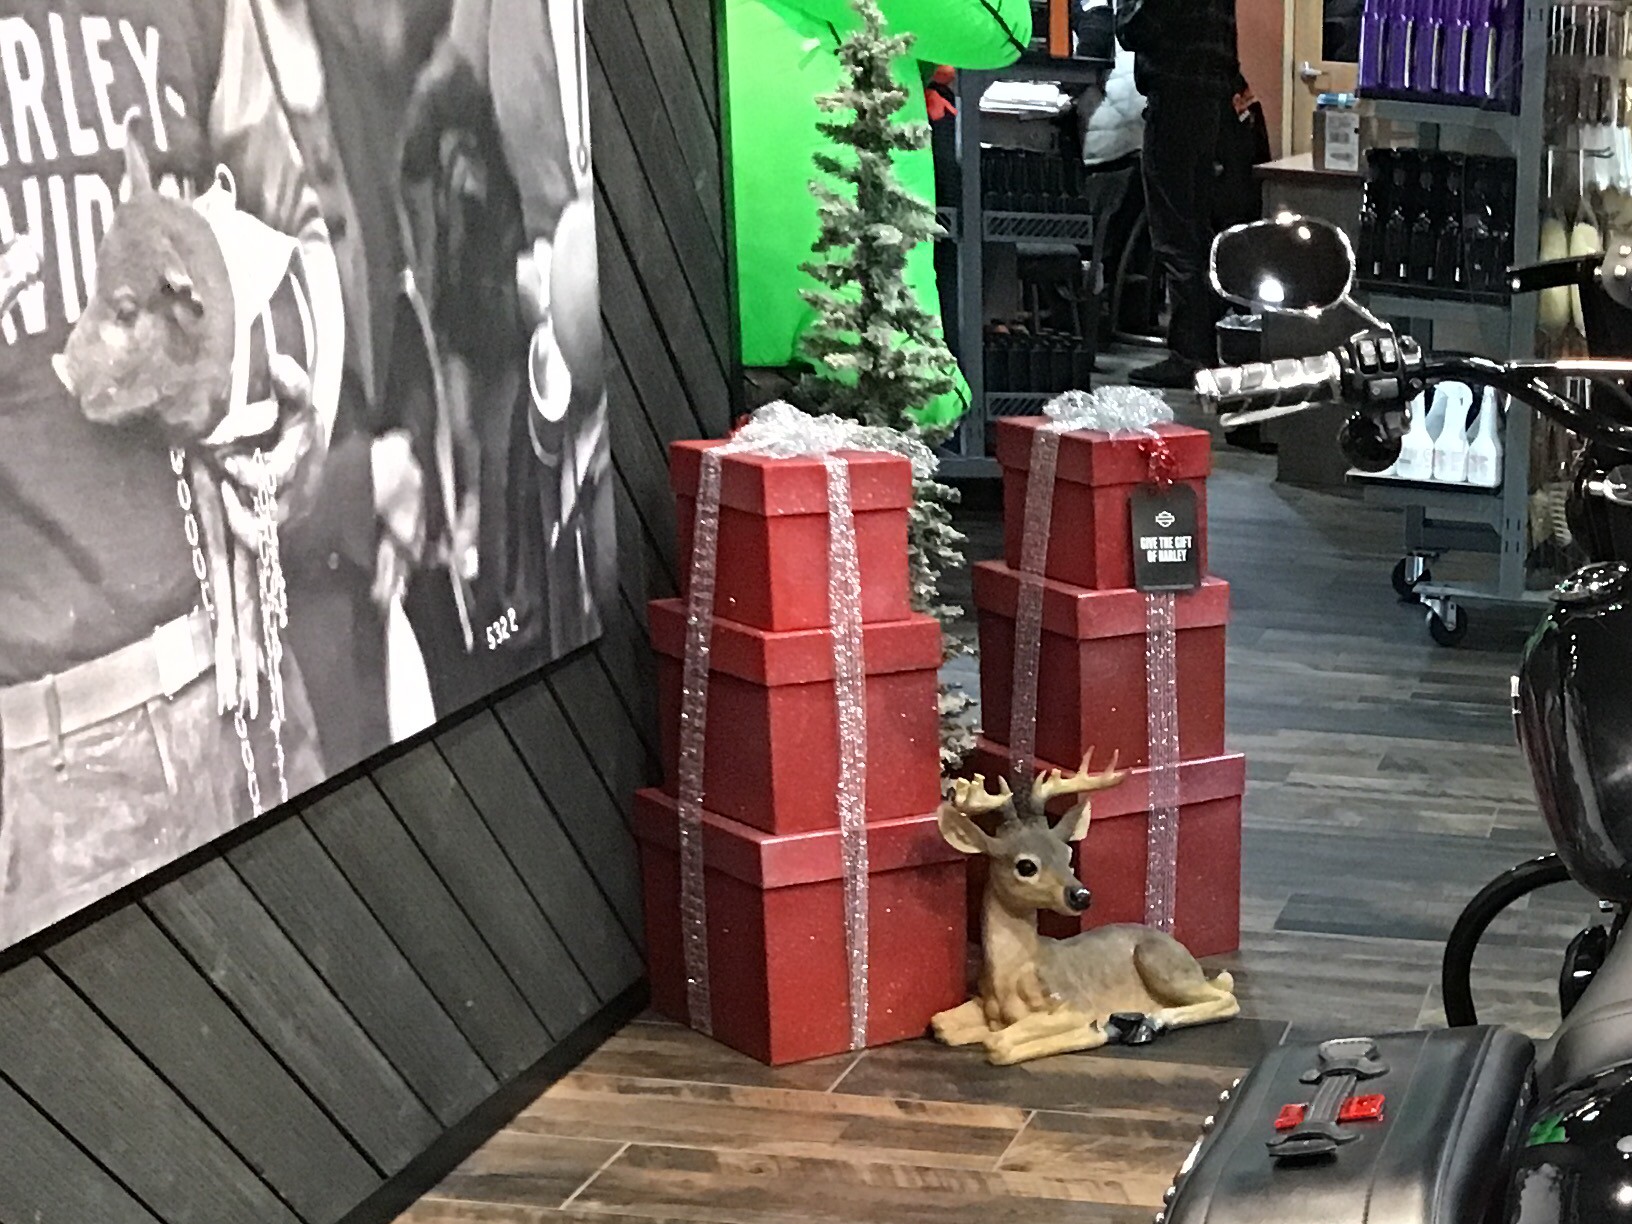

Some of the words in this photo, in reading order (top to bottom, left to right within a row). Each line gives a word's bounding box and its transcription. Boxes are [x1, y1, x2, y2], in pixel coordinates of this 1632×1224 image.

[0, 12, 186, 165] RLEY-
[1140, 536, 1158, 550] GIVE
[1159, 536, 1174, 549] THE
[1174, 535, 1192, 549] GIFT
[1147, 550, 1158, 563] OF
[1158, 549, 1187, 563] HARLEY
